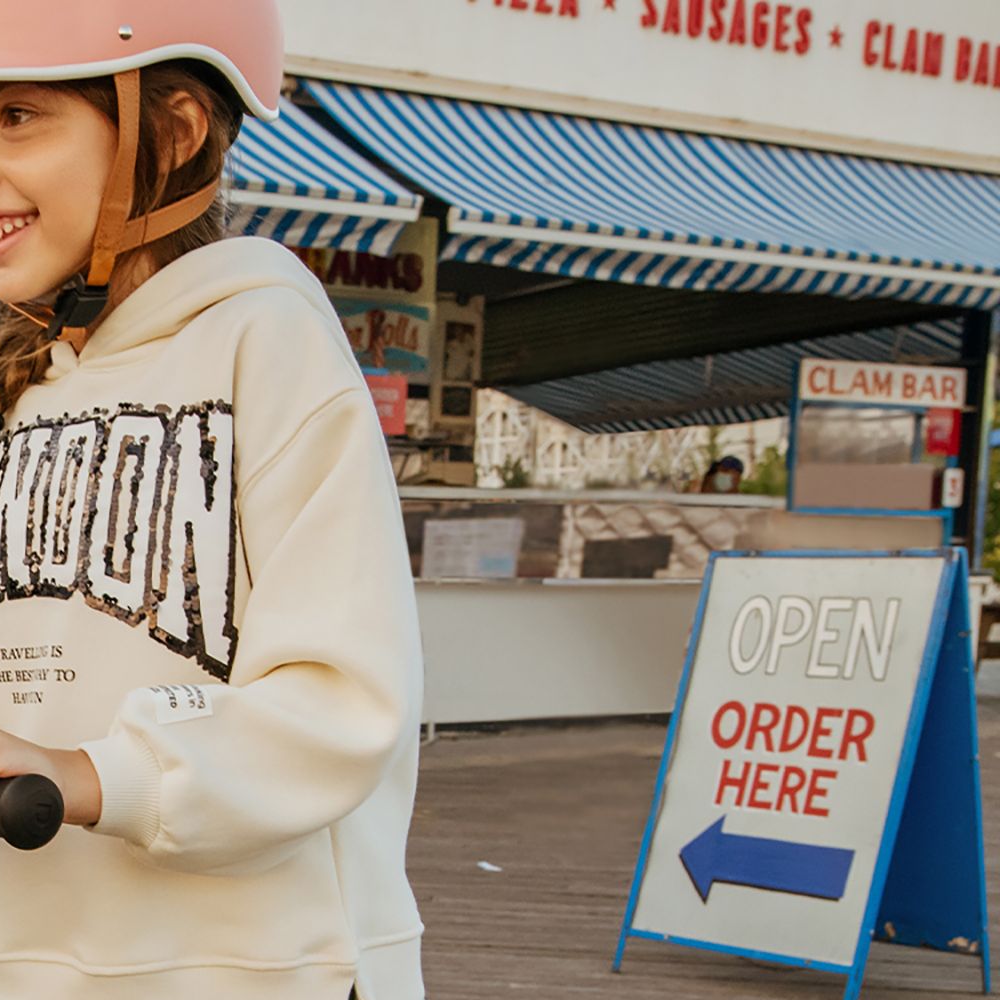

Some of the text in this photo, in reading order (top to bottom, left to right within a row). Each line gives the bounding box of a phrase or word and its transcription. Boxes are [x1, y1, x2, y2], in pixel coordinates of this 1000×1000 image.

[640, 0, 813, 55] SAUSAGES
[863, 20, 944, 77] CLAM
[326, 250, 424, 293] ANKS
[808, 366, 958, 401] CLAM BAR
[51, 645, 63, 658] IS
[728, 594, 901, 681] OPEN
[54, 669, 76, 682] TO
[711, 701, 875, 763] ORDER
[714, 760, 838, 818] HERE
